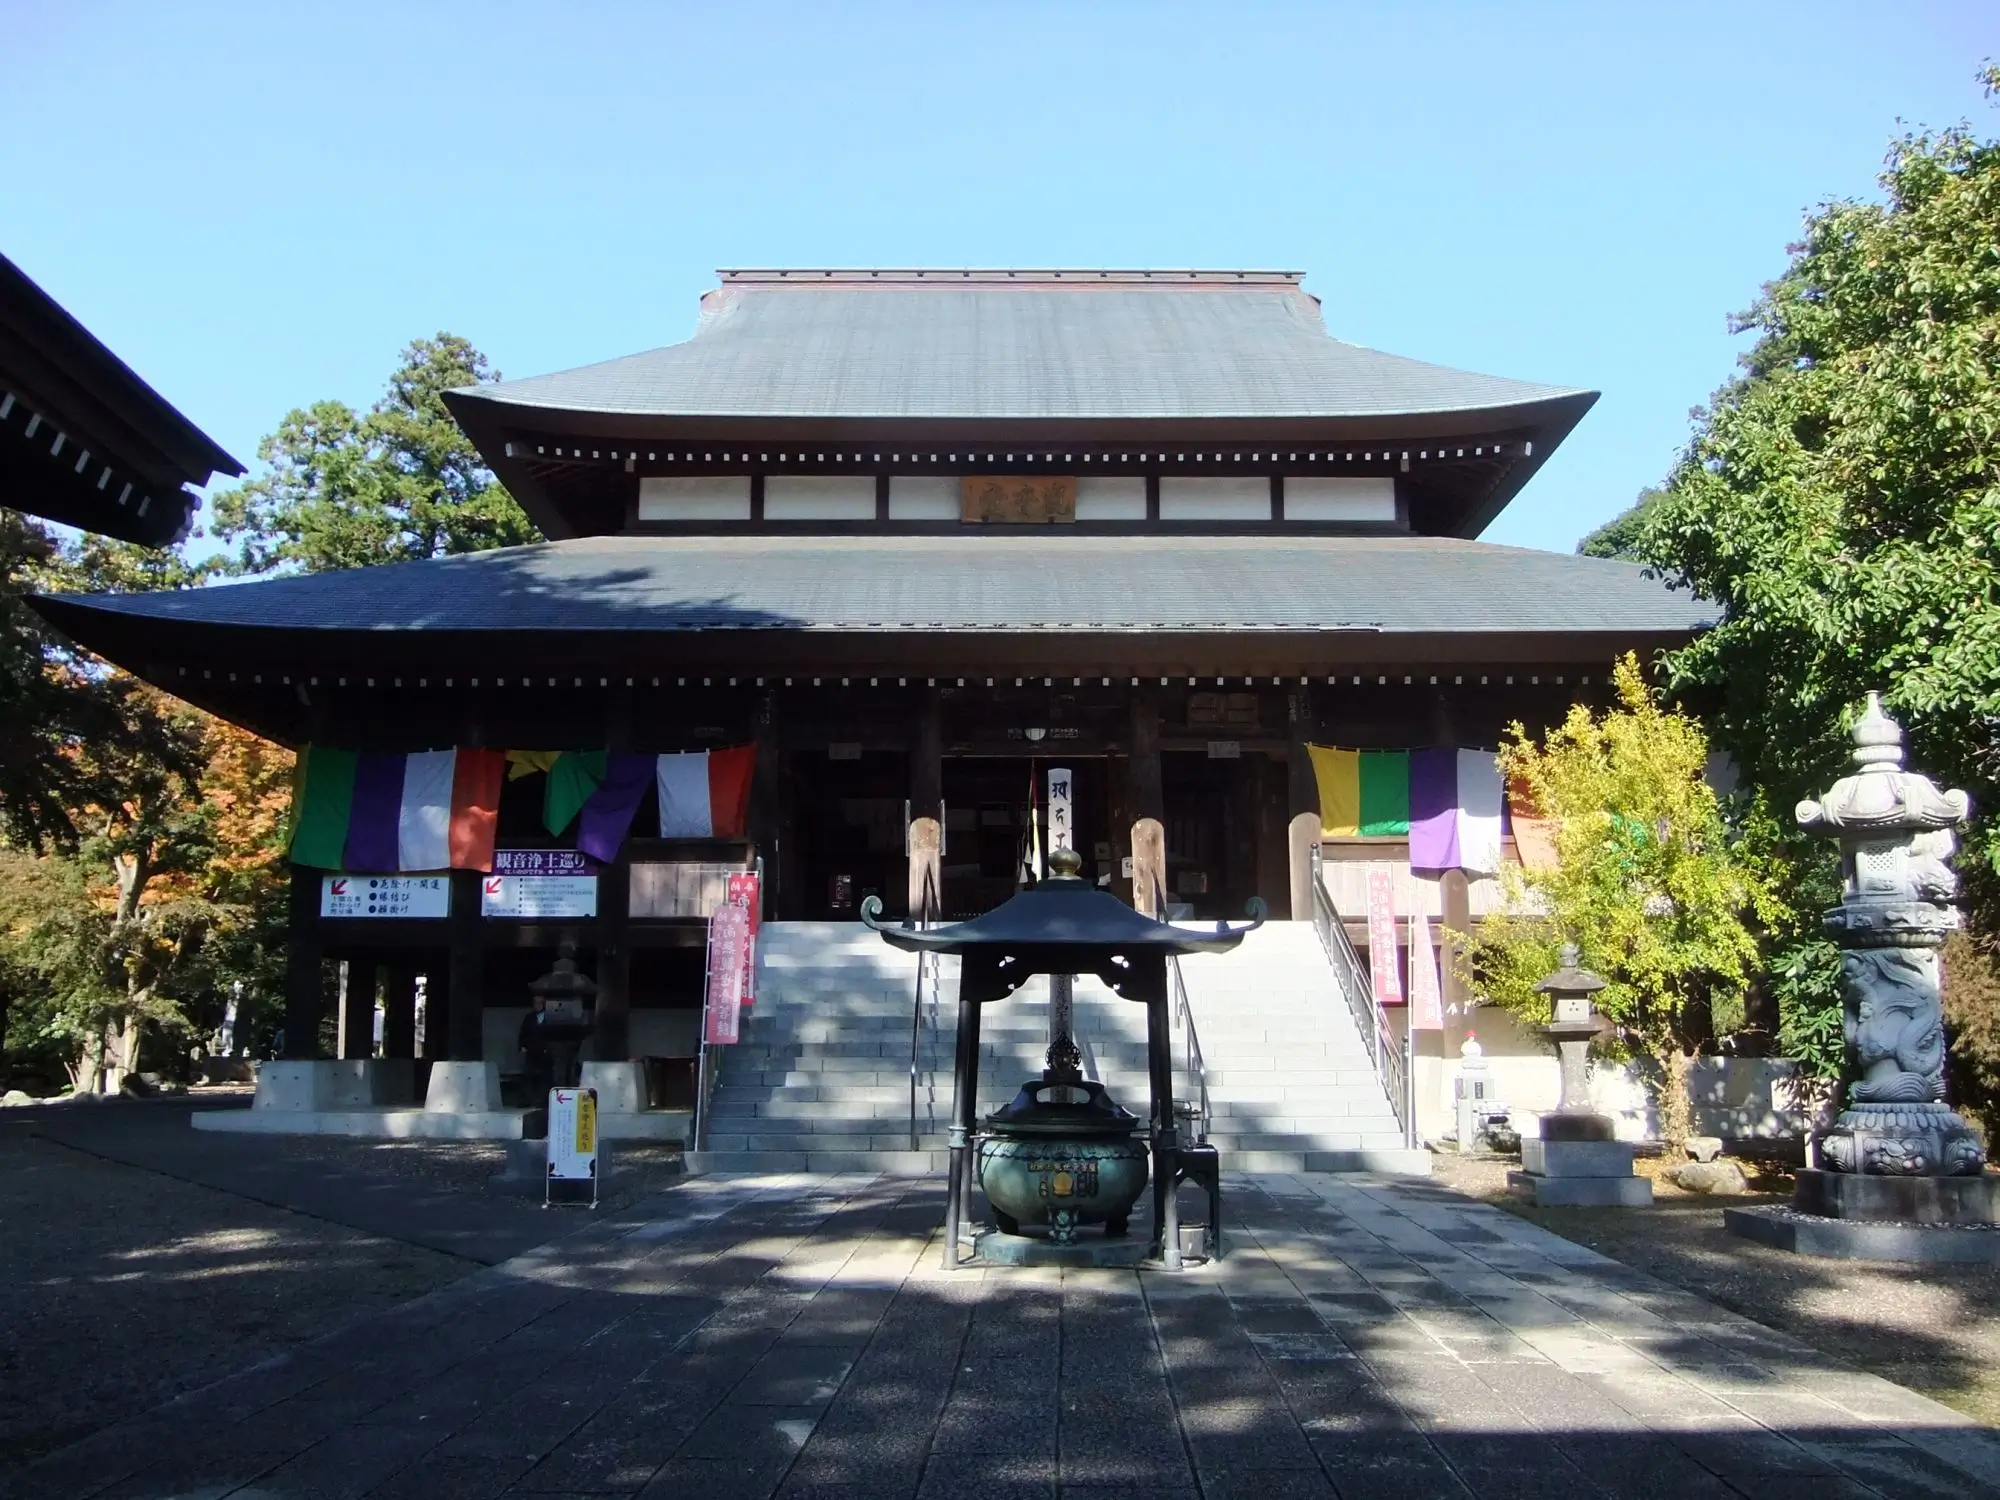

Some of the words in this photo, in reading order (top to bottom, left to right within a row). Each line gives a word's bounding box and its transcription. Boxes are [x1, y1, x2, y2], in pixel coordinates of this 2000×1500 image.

[496, 852, 585, 869] 観音浄土巡り
